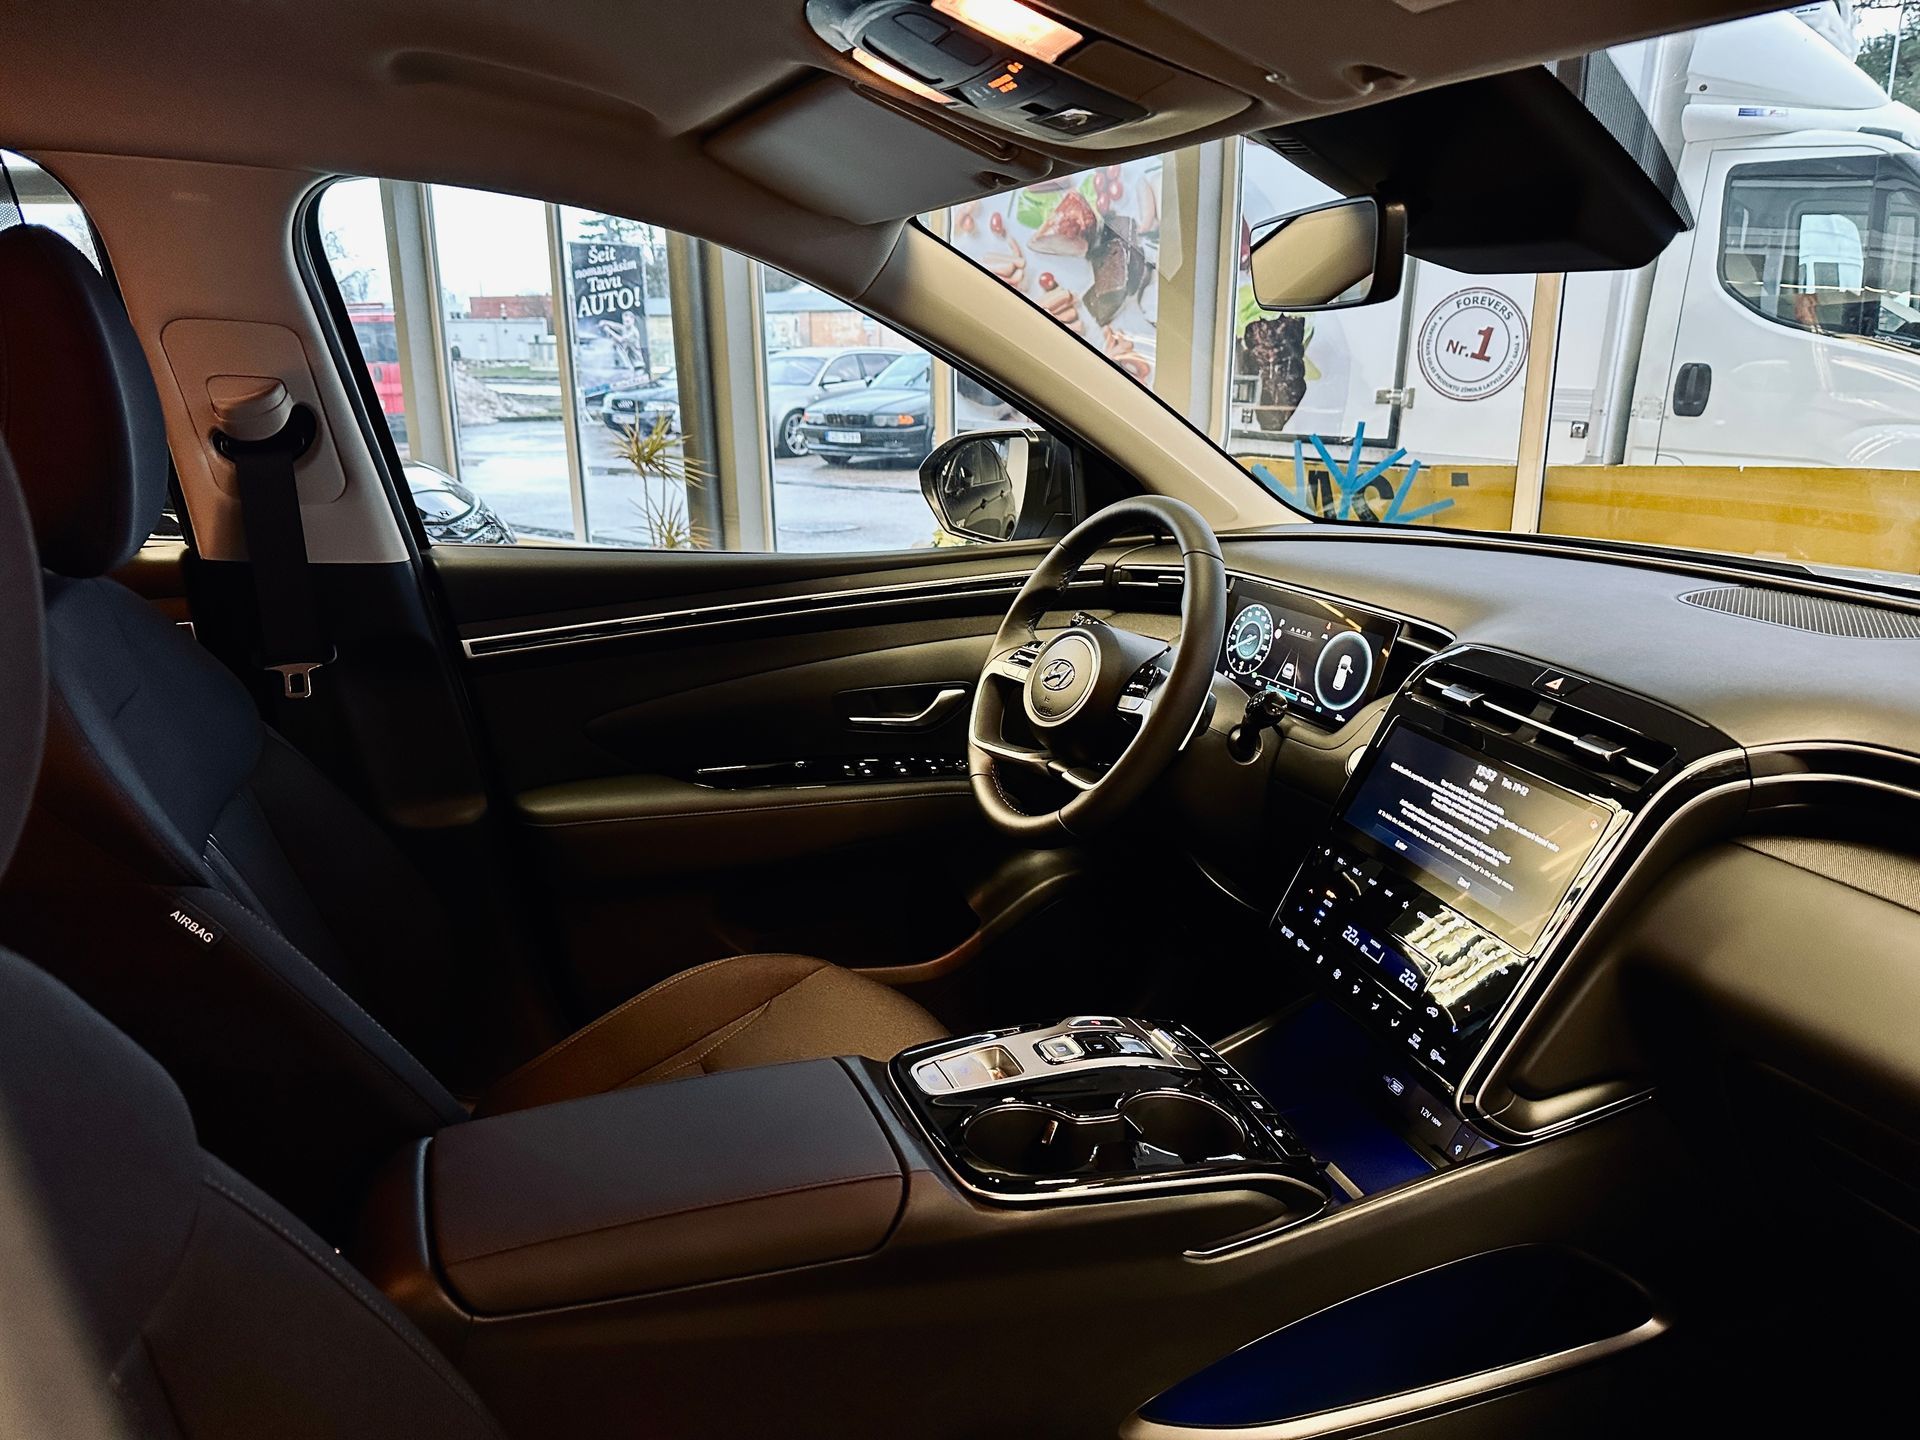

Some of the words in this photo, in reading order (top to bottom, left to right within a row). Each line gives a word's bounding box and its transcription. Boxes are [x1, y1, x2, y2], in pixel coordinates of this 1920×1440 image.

[588, 245, 616, 264] Šeit
[587, 275, 622, 292] Tavu
[577, 286, 640, 318] AUTO!
[1456, 295, 1514, 320] FOREVERS
[169, 910, 214, 943] AIRBAG
